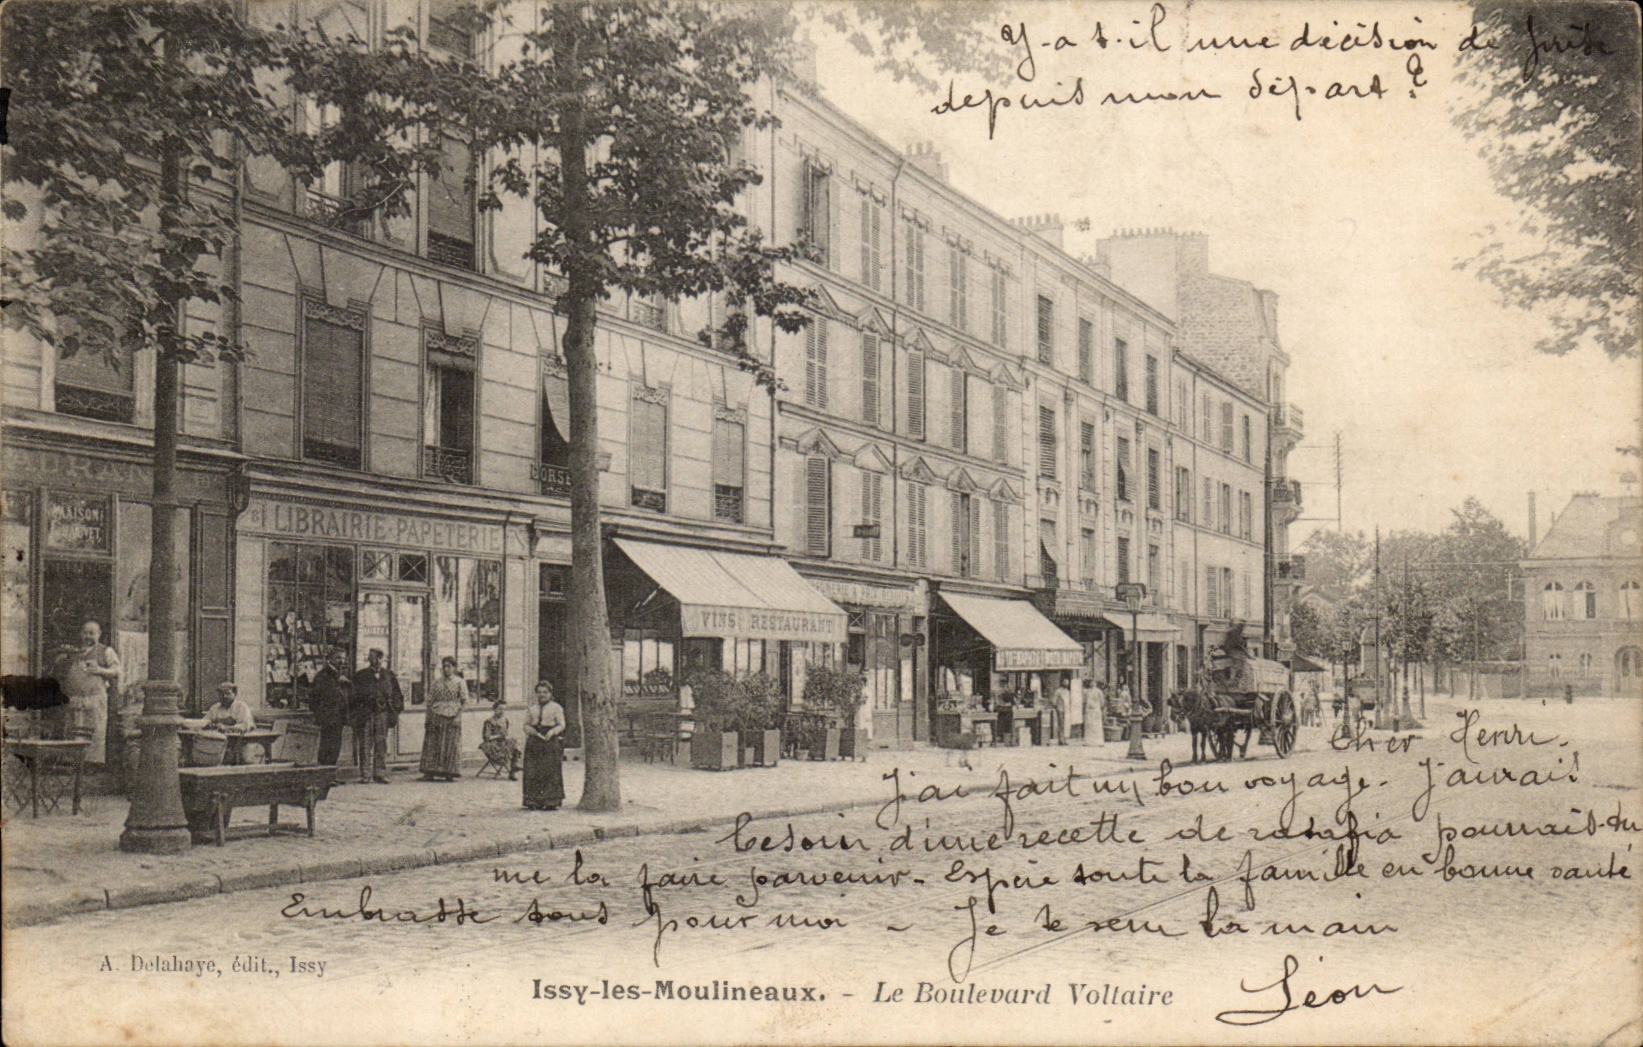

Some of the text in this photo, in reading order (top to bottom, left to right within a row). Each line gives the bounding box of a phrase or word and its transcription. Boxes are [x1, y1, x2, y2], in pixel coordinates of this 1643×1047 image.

[1187, 36, 1279, 53] une
[1291, 17, 1438, 51] décision
[1459, 25, 1499, 52] de
[931, 77, 1084, 140] depuis
[1101, 88, 1221, 105] mon
[701, 611, 833, 634] VINS RESTAURANT
[1328, 715, 1416, 753] Cher
[876, 767, 970, 830] J'ai
[988, 763, 1081, 839] fait
[1092, 780, 1145, 807] un
[1155, 759, 1230, 797] bon
[715, 812, 872, 852] besoin
[890, 817, 1002, 851] d'une
[1018, 811, 1146, 850] recette
[1164, 815, 1234, 843] de
[493, 867, 550, 885] me
[565, 849, 609, 887] la
[636, 856, 727, 915] faire
[1072, 856, 1169, 884] toute
[1182, 853, 1214, 883] la
[1236, 850, 1370, 912] famille
[1382, 862, 1424, 877] en
[1433, 843, 1535, 882] bonne
[1551, 843, 1632, 880] santé
[281, 886, 501, 925] Embrasse
[632, 900, 759, 968] pour
[948, 896, 1007, 982] Je
[1033, 904, 1069, 932] te
[1198, 886, 1250, 938] la
[1260, 892, 1399, 937] main
[1215, 955, 1404, 1027] Léon
